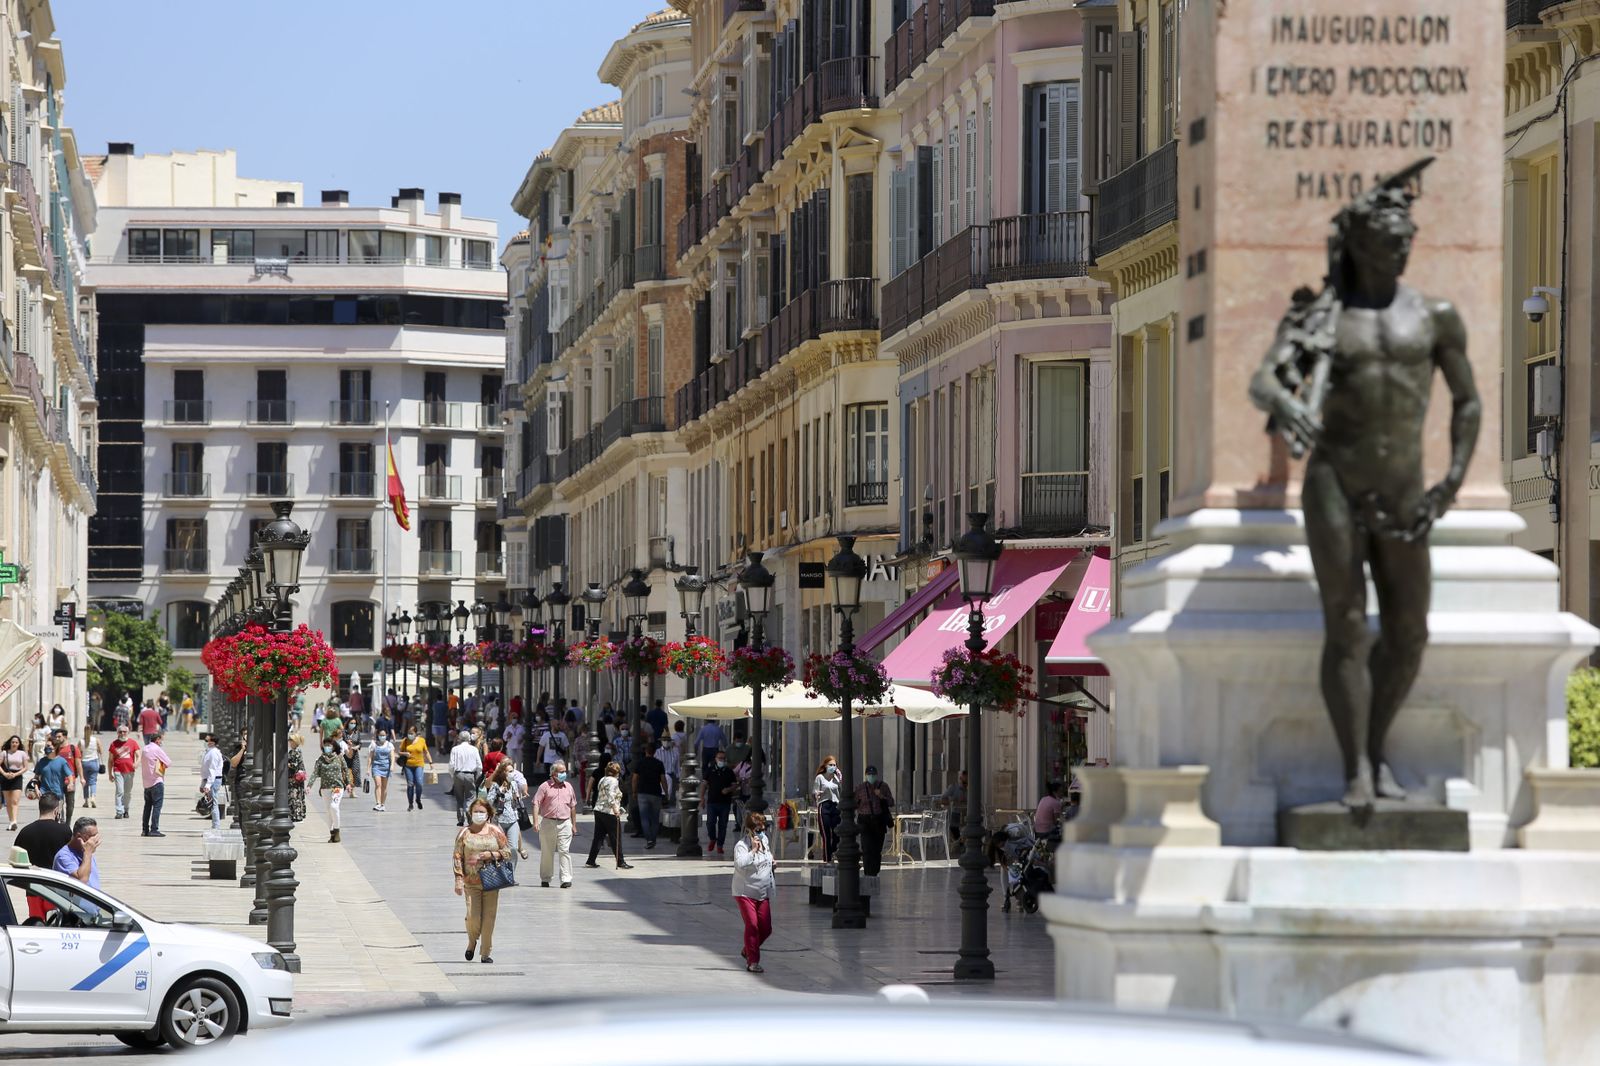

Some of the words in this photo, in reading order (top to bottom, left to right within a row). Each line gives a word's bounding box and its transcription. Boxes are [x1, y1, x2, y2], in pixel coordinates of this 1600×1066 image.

[1266, 66, 1337, 96] ENERO
[1266, 118, 1452, 149] RESTAURACION
[1296, 172, 1363, 200] MAYO
[61, 932, 81, 940] TAXI
[61, 942, 80, 950] 297
